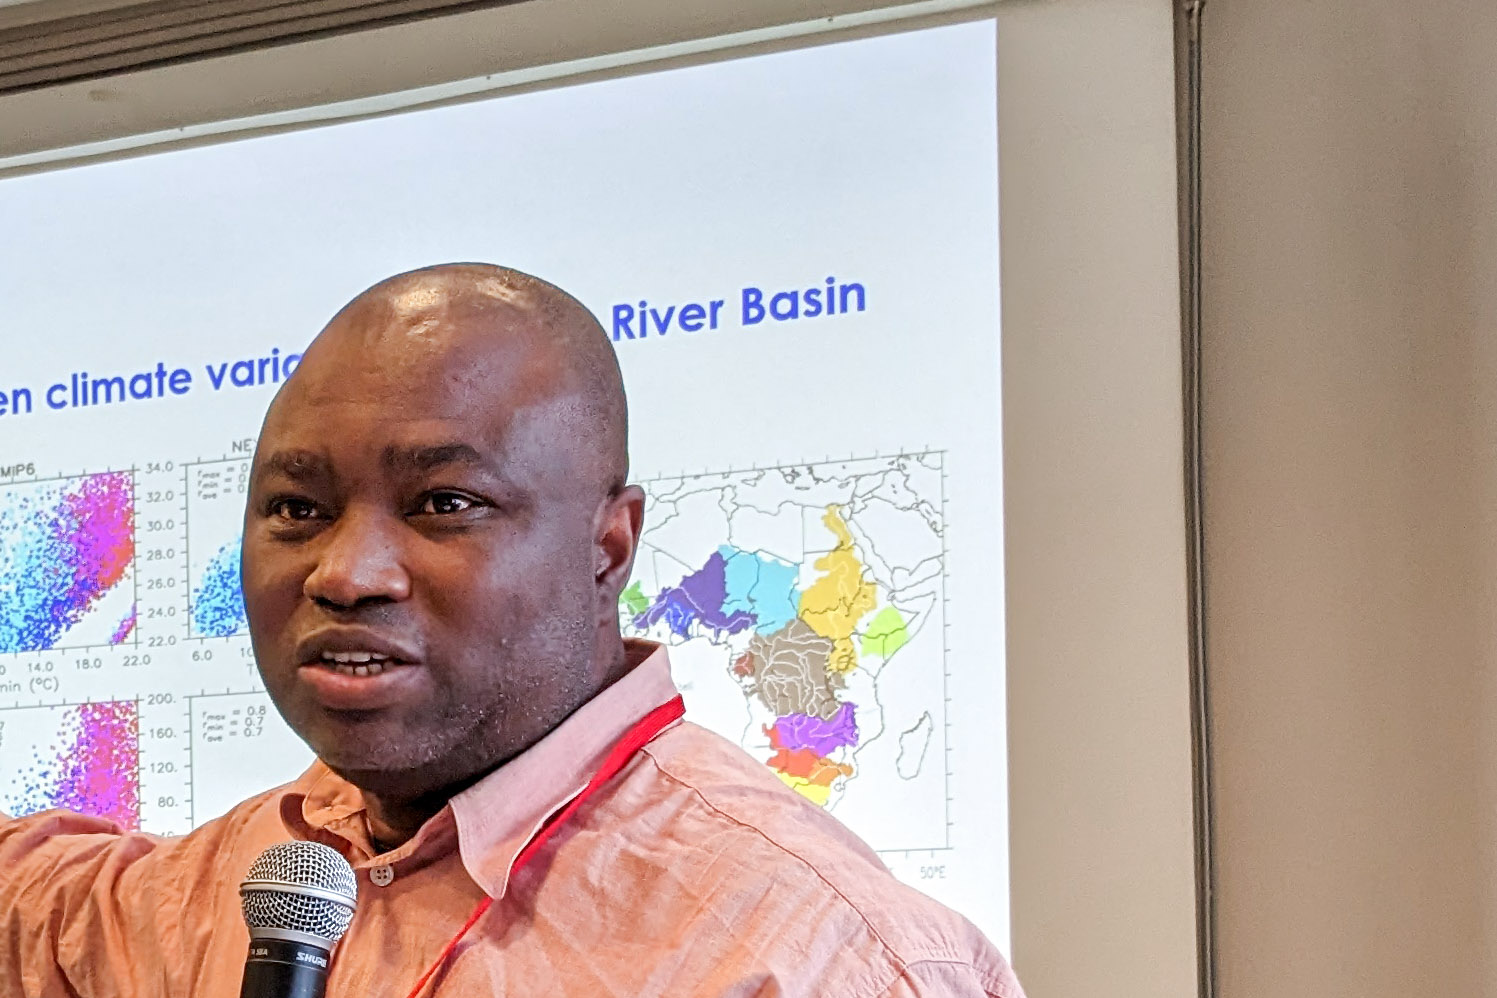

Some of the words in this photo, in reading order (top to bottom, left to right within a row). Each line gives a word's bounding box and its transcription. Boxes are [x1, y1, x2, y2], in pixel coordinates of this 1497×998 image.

[47, 362, 192, 410] climate
[612, 300, 724, 341] River
[742, 276, 866, 326] Basin
[232, 439, 256, 452] NE
[146, 461, 174, 474] 34.0
[146, 491, 174, 503] 32.0
[147, 519, 174, 531] 30.0
[148, 548, 175, 560] 28.0
[148, 577, 175, 589] 26.0
[148, 606, 176, 618] 24.0
[149, 635, 176, 647] 22.0
[192, 650, 212, 661] 6.0
[28, 662, 54, 673] 14.0
[76, 658, 102, 670] 18.0
[123, 655, 151, 666] 22.0
[148, 693, 176, 705] 200.
[245, 717, 264, 726] 0.7
[150, 728, 176, 739] 160.
[244, 727, 263, 737] 0.7
[150, 762, 178, 774] 120.
[158, 796, 178, 808] 80.
